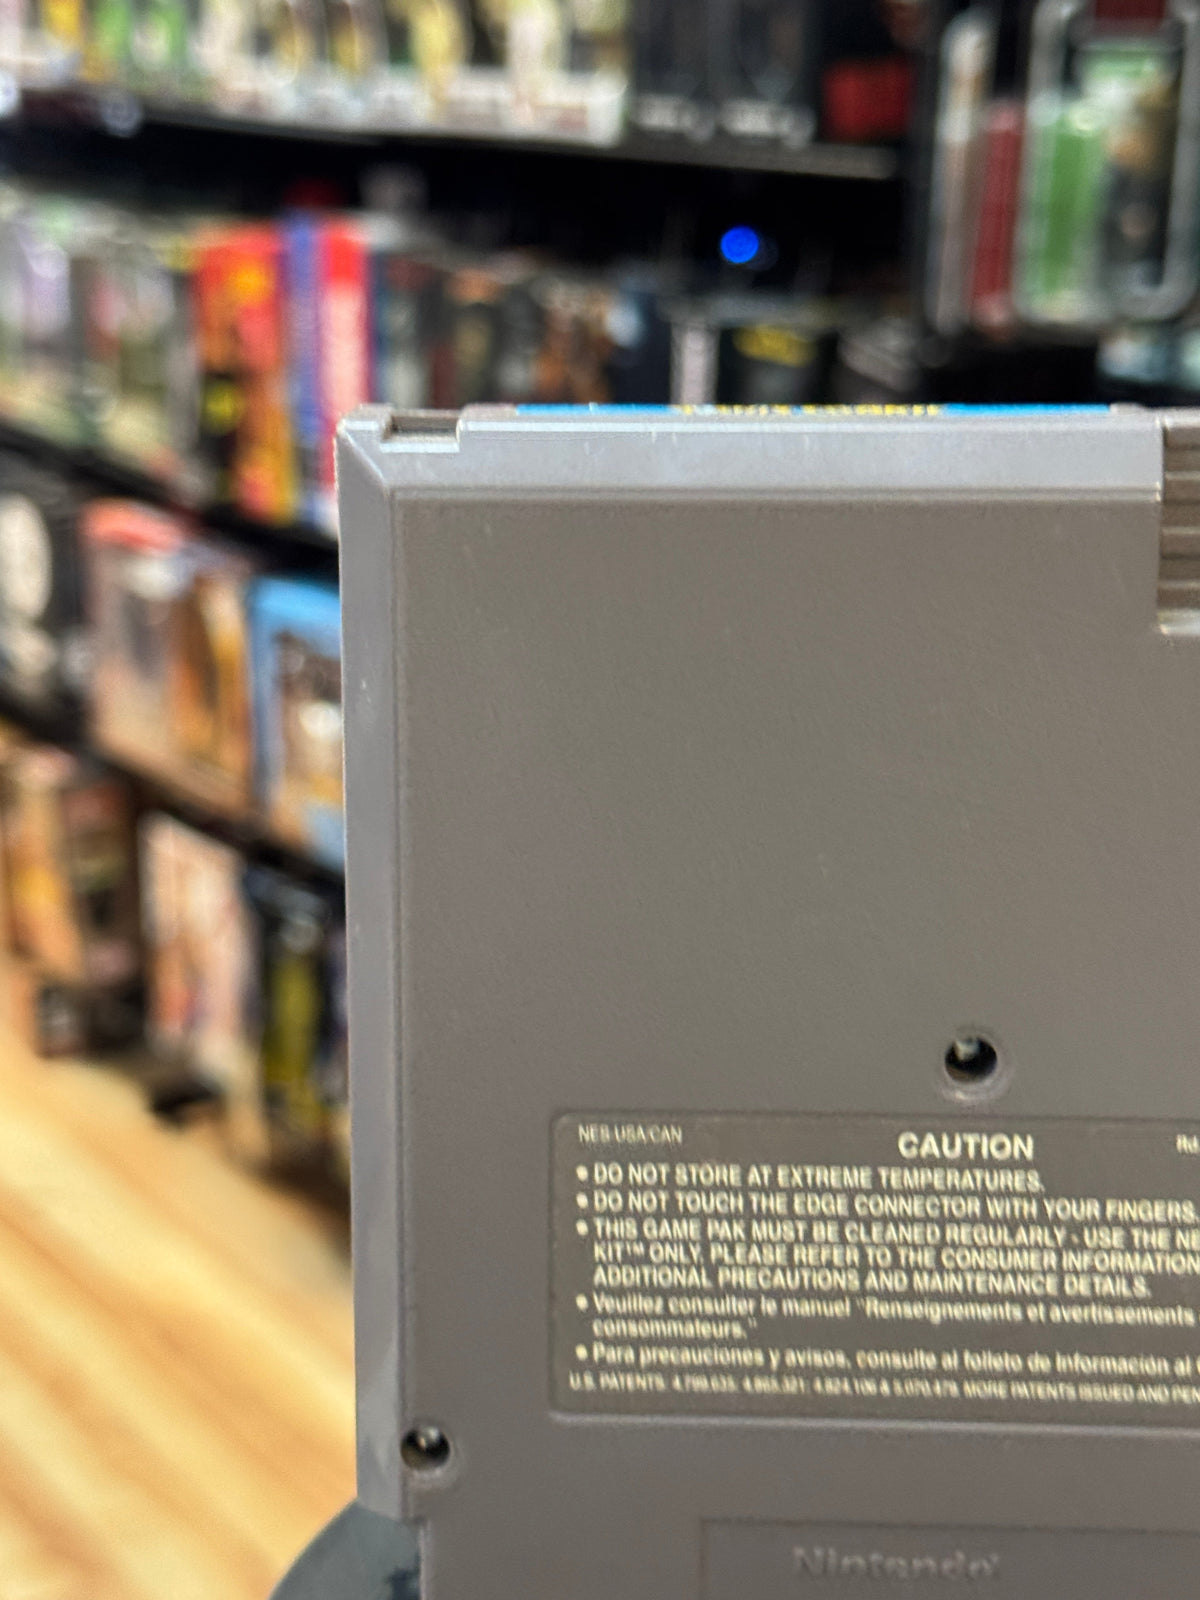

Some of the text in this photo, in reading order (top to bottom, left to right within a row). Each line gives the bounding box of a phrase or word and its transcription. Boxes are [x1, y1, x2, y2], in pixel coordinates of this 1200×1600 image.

[898, 1132, 1034, 1161] CAUTION
[594, 1162, 1045, 1194] DO NOT STORE AT EXTREME TEMPERATURES.
[594, 1190, 623, 1212] DO
[628, 1190, 669, 1213] NOT
[675, 1190, 744, 1214] TOUCH
[749, 1192, 787, 1215] THE
[794, 1192, 848, 1216] EDGE
[854, 1194, 981, 1218] CONNECTOR
[986, 1196, 1038, 1219] WITH
[1044, 1198, 1101, 1221] YOUR
[593, 1217, 638, 1240] THIS
[643, 1217, 701, 1241] GAME
[707, 1218, 746, 1241] PAK
[752, 1219, 807, 1243] MUST
[813, 1220, 839, 1243] BE
[845, 1221, 941, 1246] CLEANED
[946, 1223, 1066, 1250] REGULARLY
[1084, 1226, 1125, 1250] USE
[1131, 1227, 1171, 1251] THE
[710, 1242, 787, 1266] PLEASE
[793, 1243, 859, 1267] REFER
[865, 1246, 892, 1268] TO
[897, 1247, 935, 1269] THE
[941, 1247, 1058, 1270] CONSUMER
[1062, 1250, 1200, 1276] INFORMATION
[594, 1264, 1151, 1298] ADDITIONAL PRECAUTIONS AND MAINTENANCE DETAILS.
[593, 1292, 663, 1314] Veuillez
[668, 1295, 755, 1316] consulter
[769, 1349, 780, 1371] y
